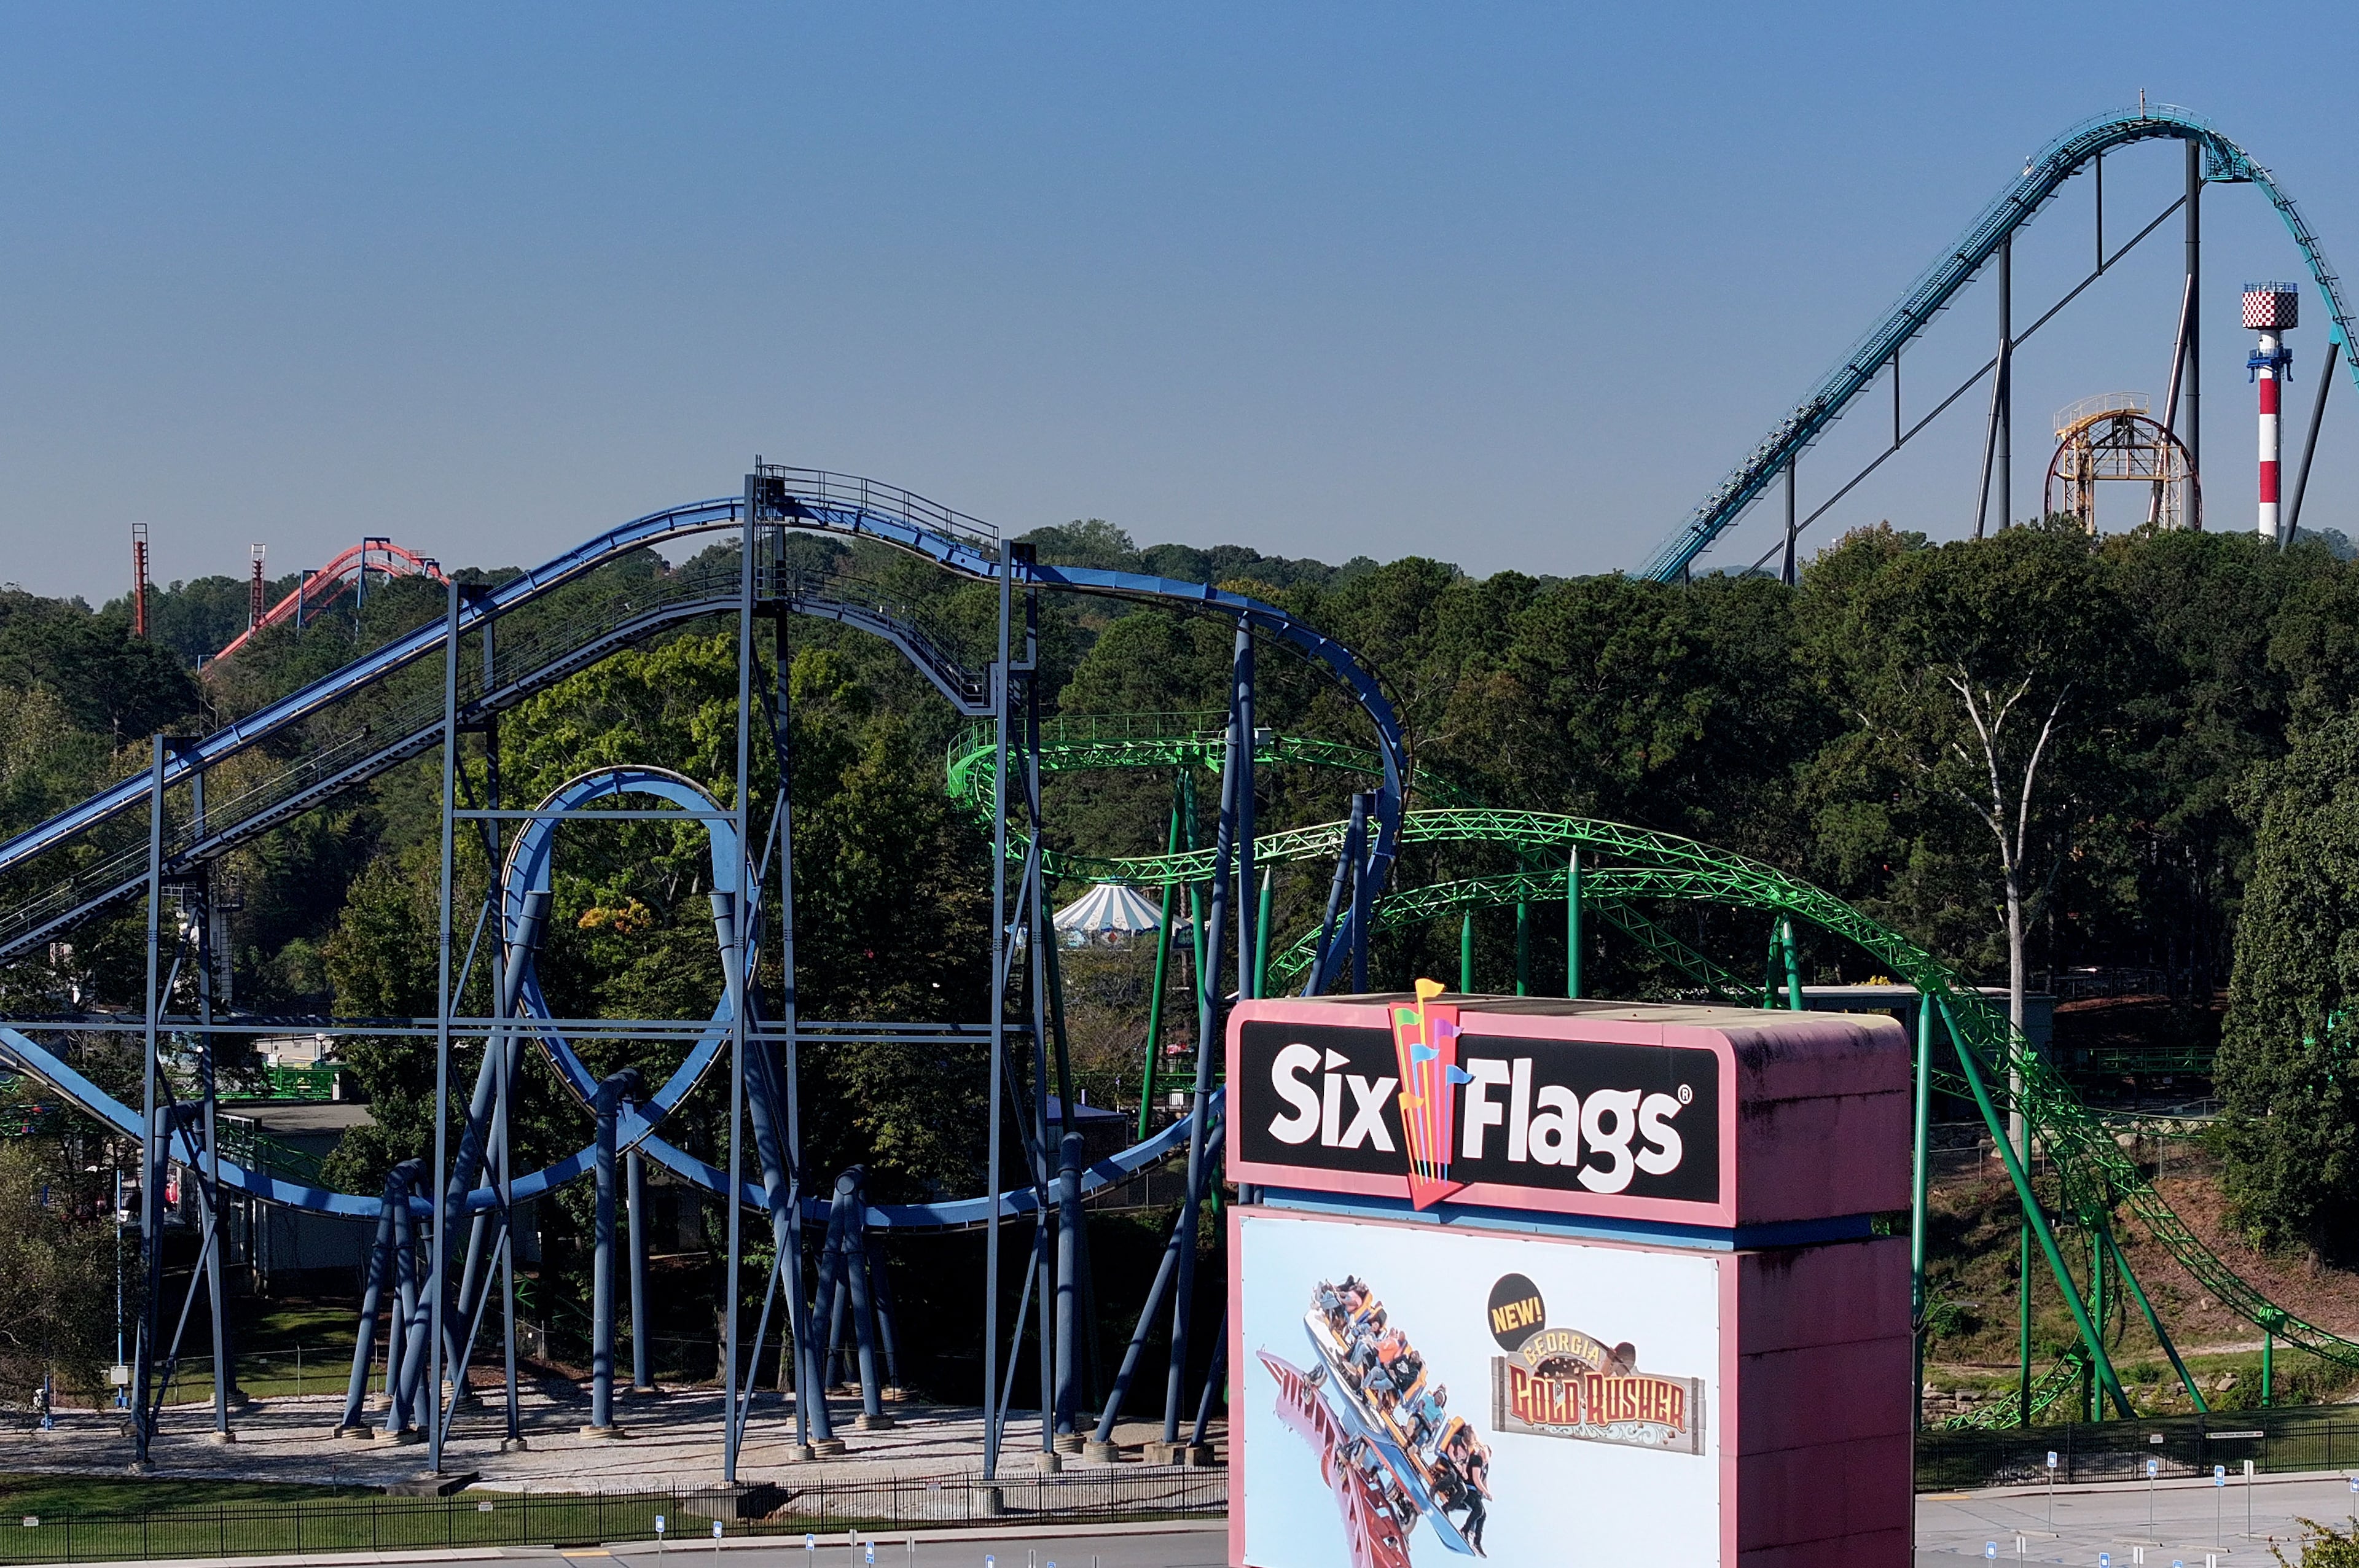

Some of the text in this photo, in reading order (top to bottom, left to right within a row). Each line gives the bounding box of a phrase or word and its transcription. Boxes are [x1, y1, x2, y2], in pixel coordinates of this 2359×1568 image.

[1267, 1043, 1399, 1153] Six
[1491, 1296, 1543, 1334] NEW!
[1524, 1332, 1601, 1367] GEORGIA
[1508, 1363, 1686, 1434] GOLD RUSHER
